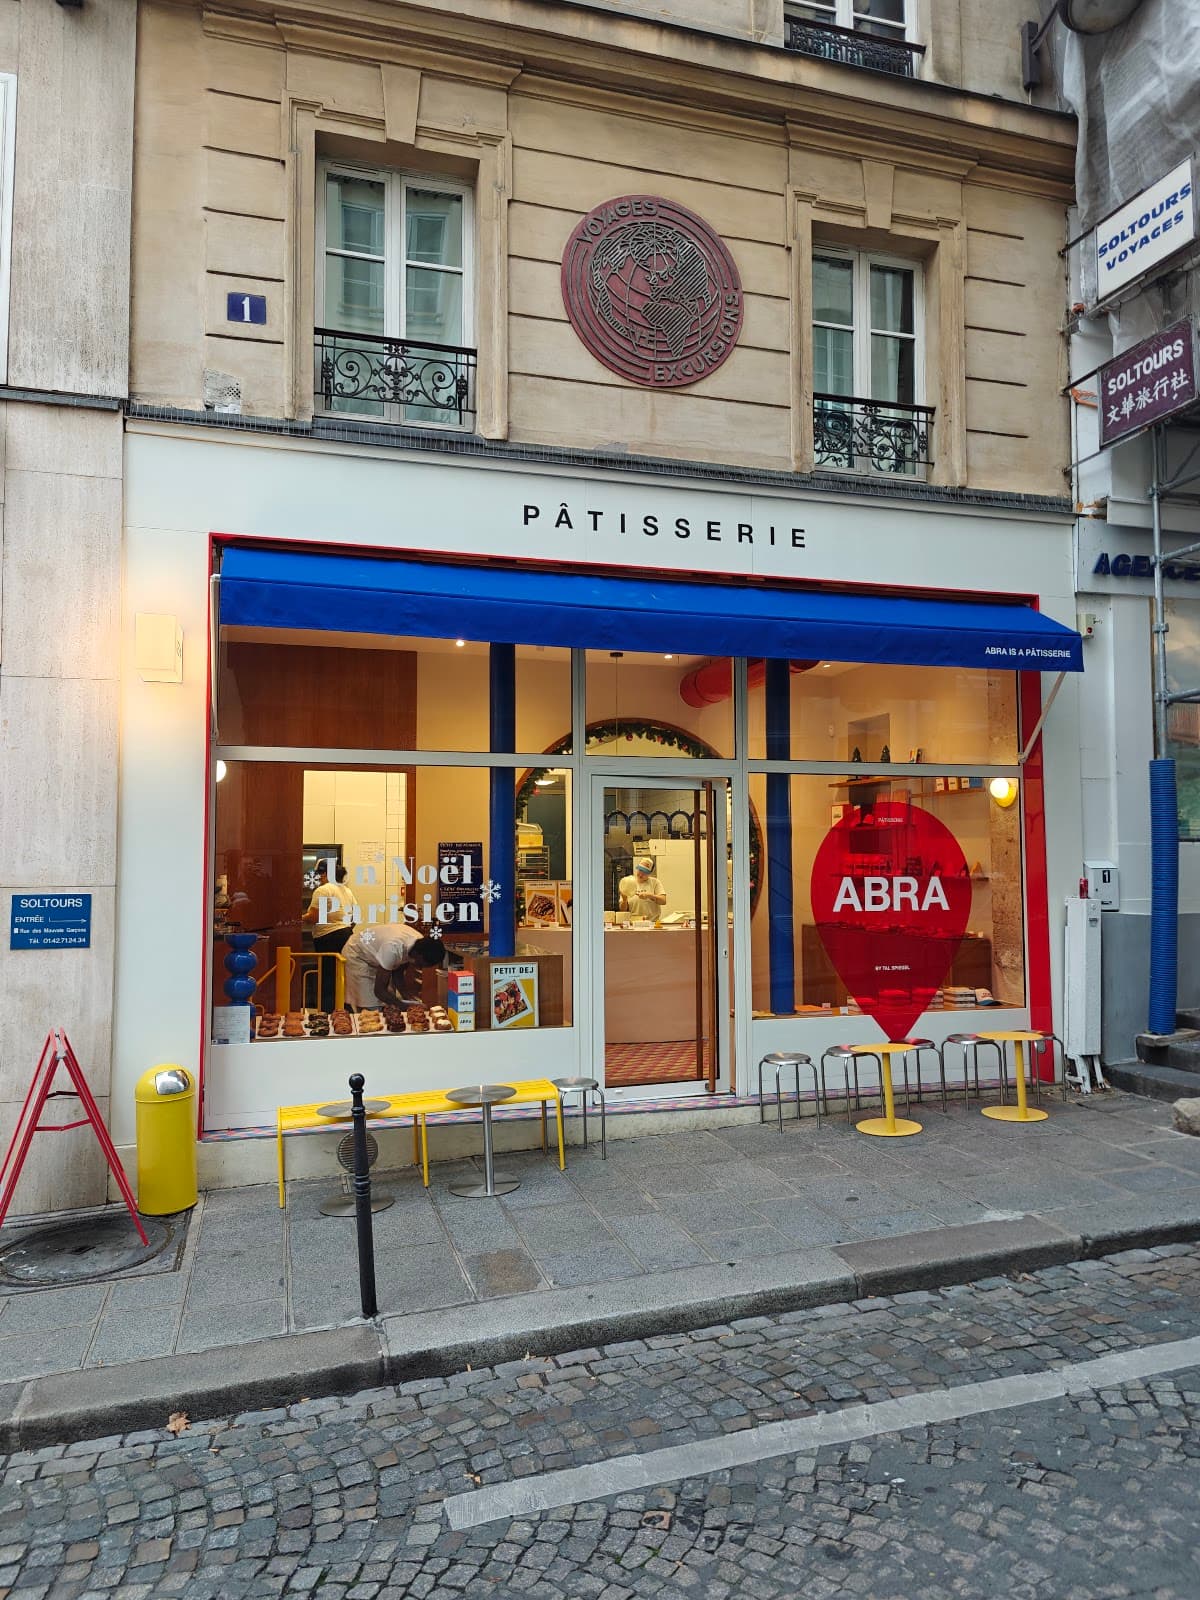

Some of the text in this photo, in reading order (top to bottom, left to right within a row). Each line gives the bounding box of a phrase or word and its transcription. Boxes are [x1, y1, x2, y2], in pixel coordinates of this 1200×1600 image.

[577, 199, 658, 244] VOYAGES
[1098, 182, 1192, 259] SOLTOURS
[1105, 210, 1185, 271] VOYAGES
[241, 296, 252, 322] 1
[654, 288, 739, 381] EXCURSIONS
[1107, 339, 1184, 396] SOLTOURS
[523, 502, 806, 548] PÂTISSERIE
[985, 646, 1071, 658] ABRA IS A PÂTISSERIE
[323, 854, 474, 886] Un Noël
[20, 898, 83, 908] SOLTOURS
[315, 893, 481, 924] Parisien
[832, 876, 950, 913] ABRA
[15, 914, 45, 923] ENTRÉE
[494, 966, 534, 975] PETIT DEJ
